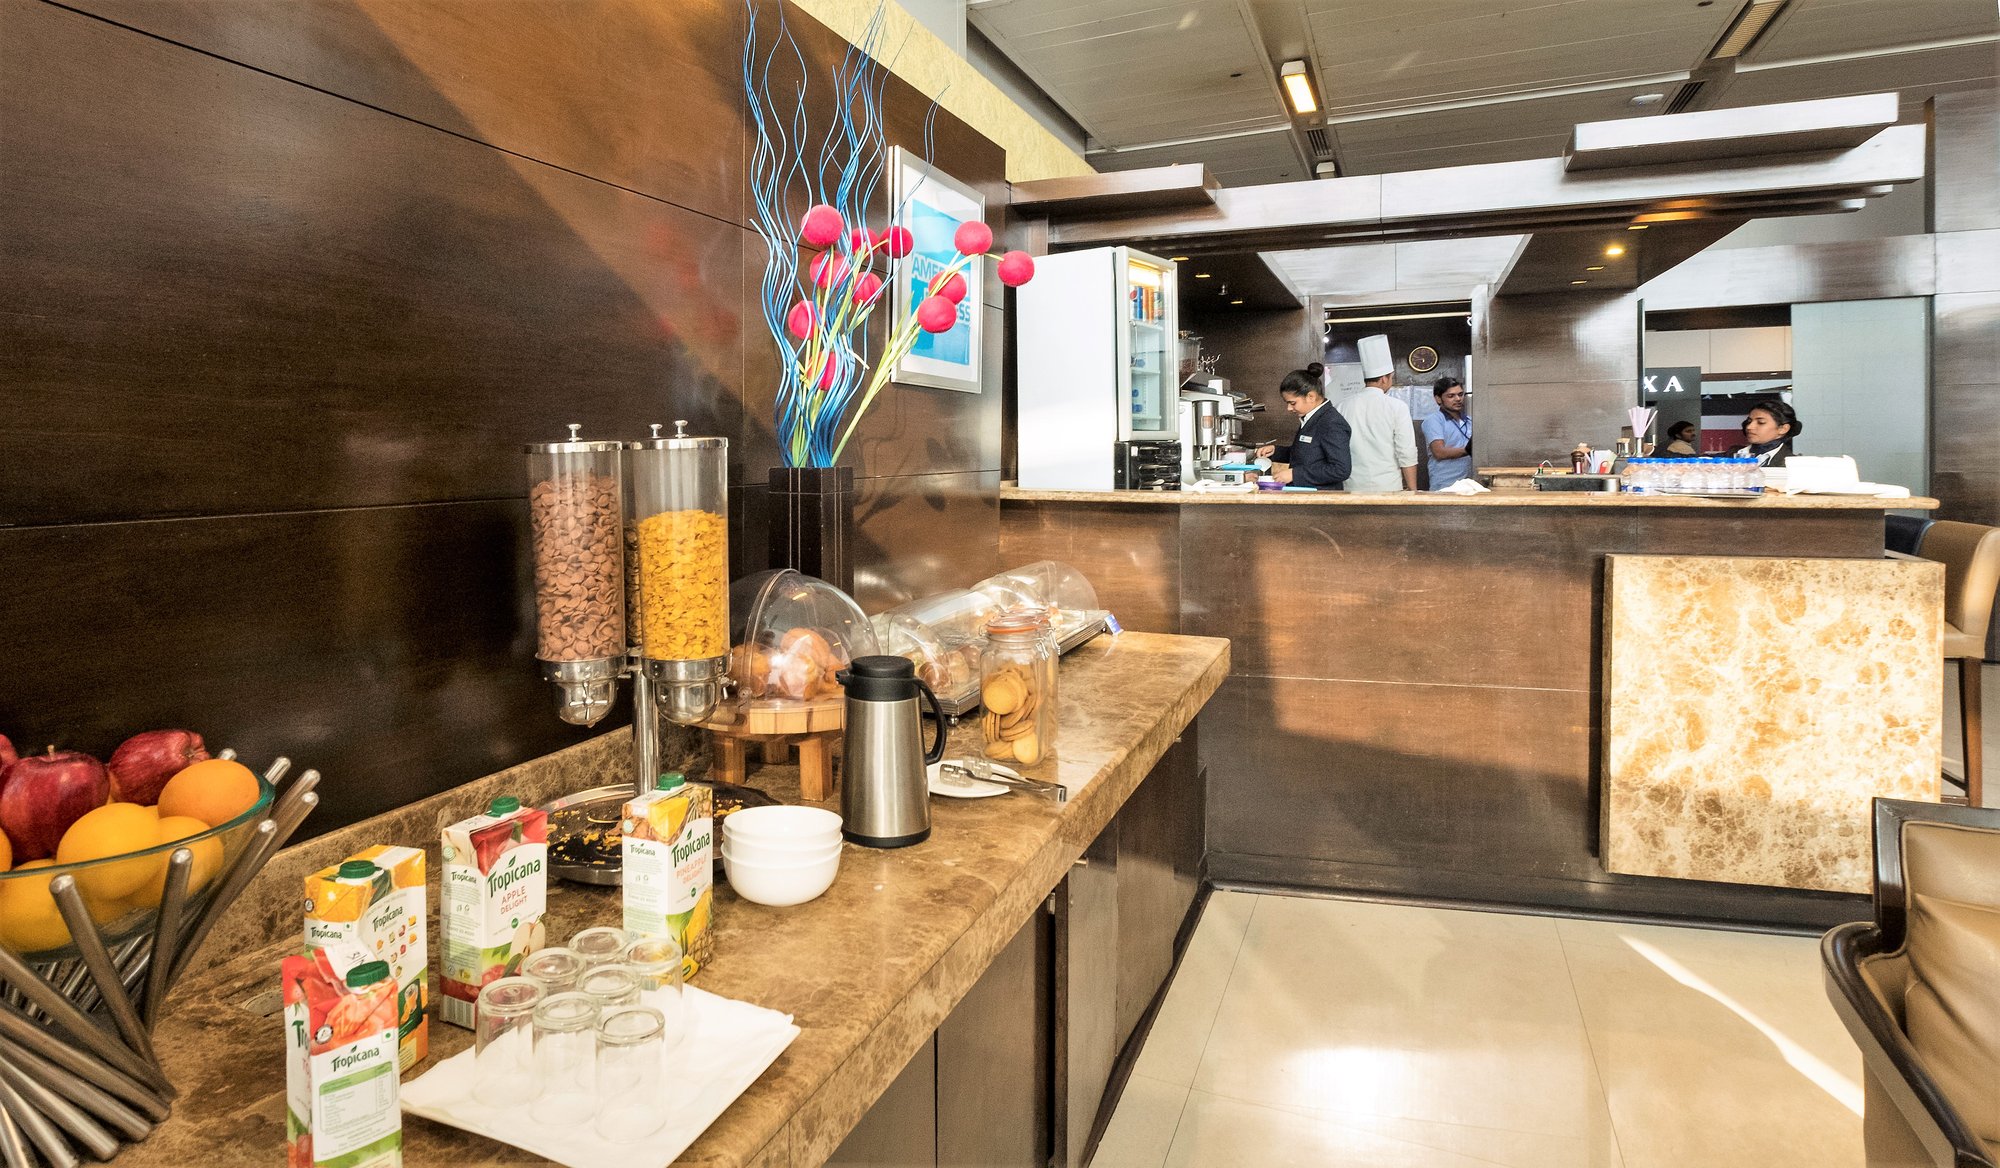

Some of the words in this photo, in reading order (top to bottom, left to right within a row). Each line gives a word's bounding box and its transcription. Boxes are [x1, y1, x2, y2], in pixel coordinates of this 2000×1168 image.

[630, 843, 656, 856] Tropicana
[671, 829, 710, 868] Tropicana
[451, 869, 477, 884] Tropicana
[487, 856, 541, 898] Tropicana
[500, 895, 528, 915] DELIGHT
[501, 885, 526, 905] APPLE
[372, 906, 403, 932] Tropicana
[310, 924, 342, 940] Tropicana
[331, 1045, 380, 1072] Tropicana
